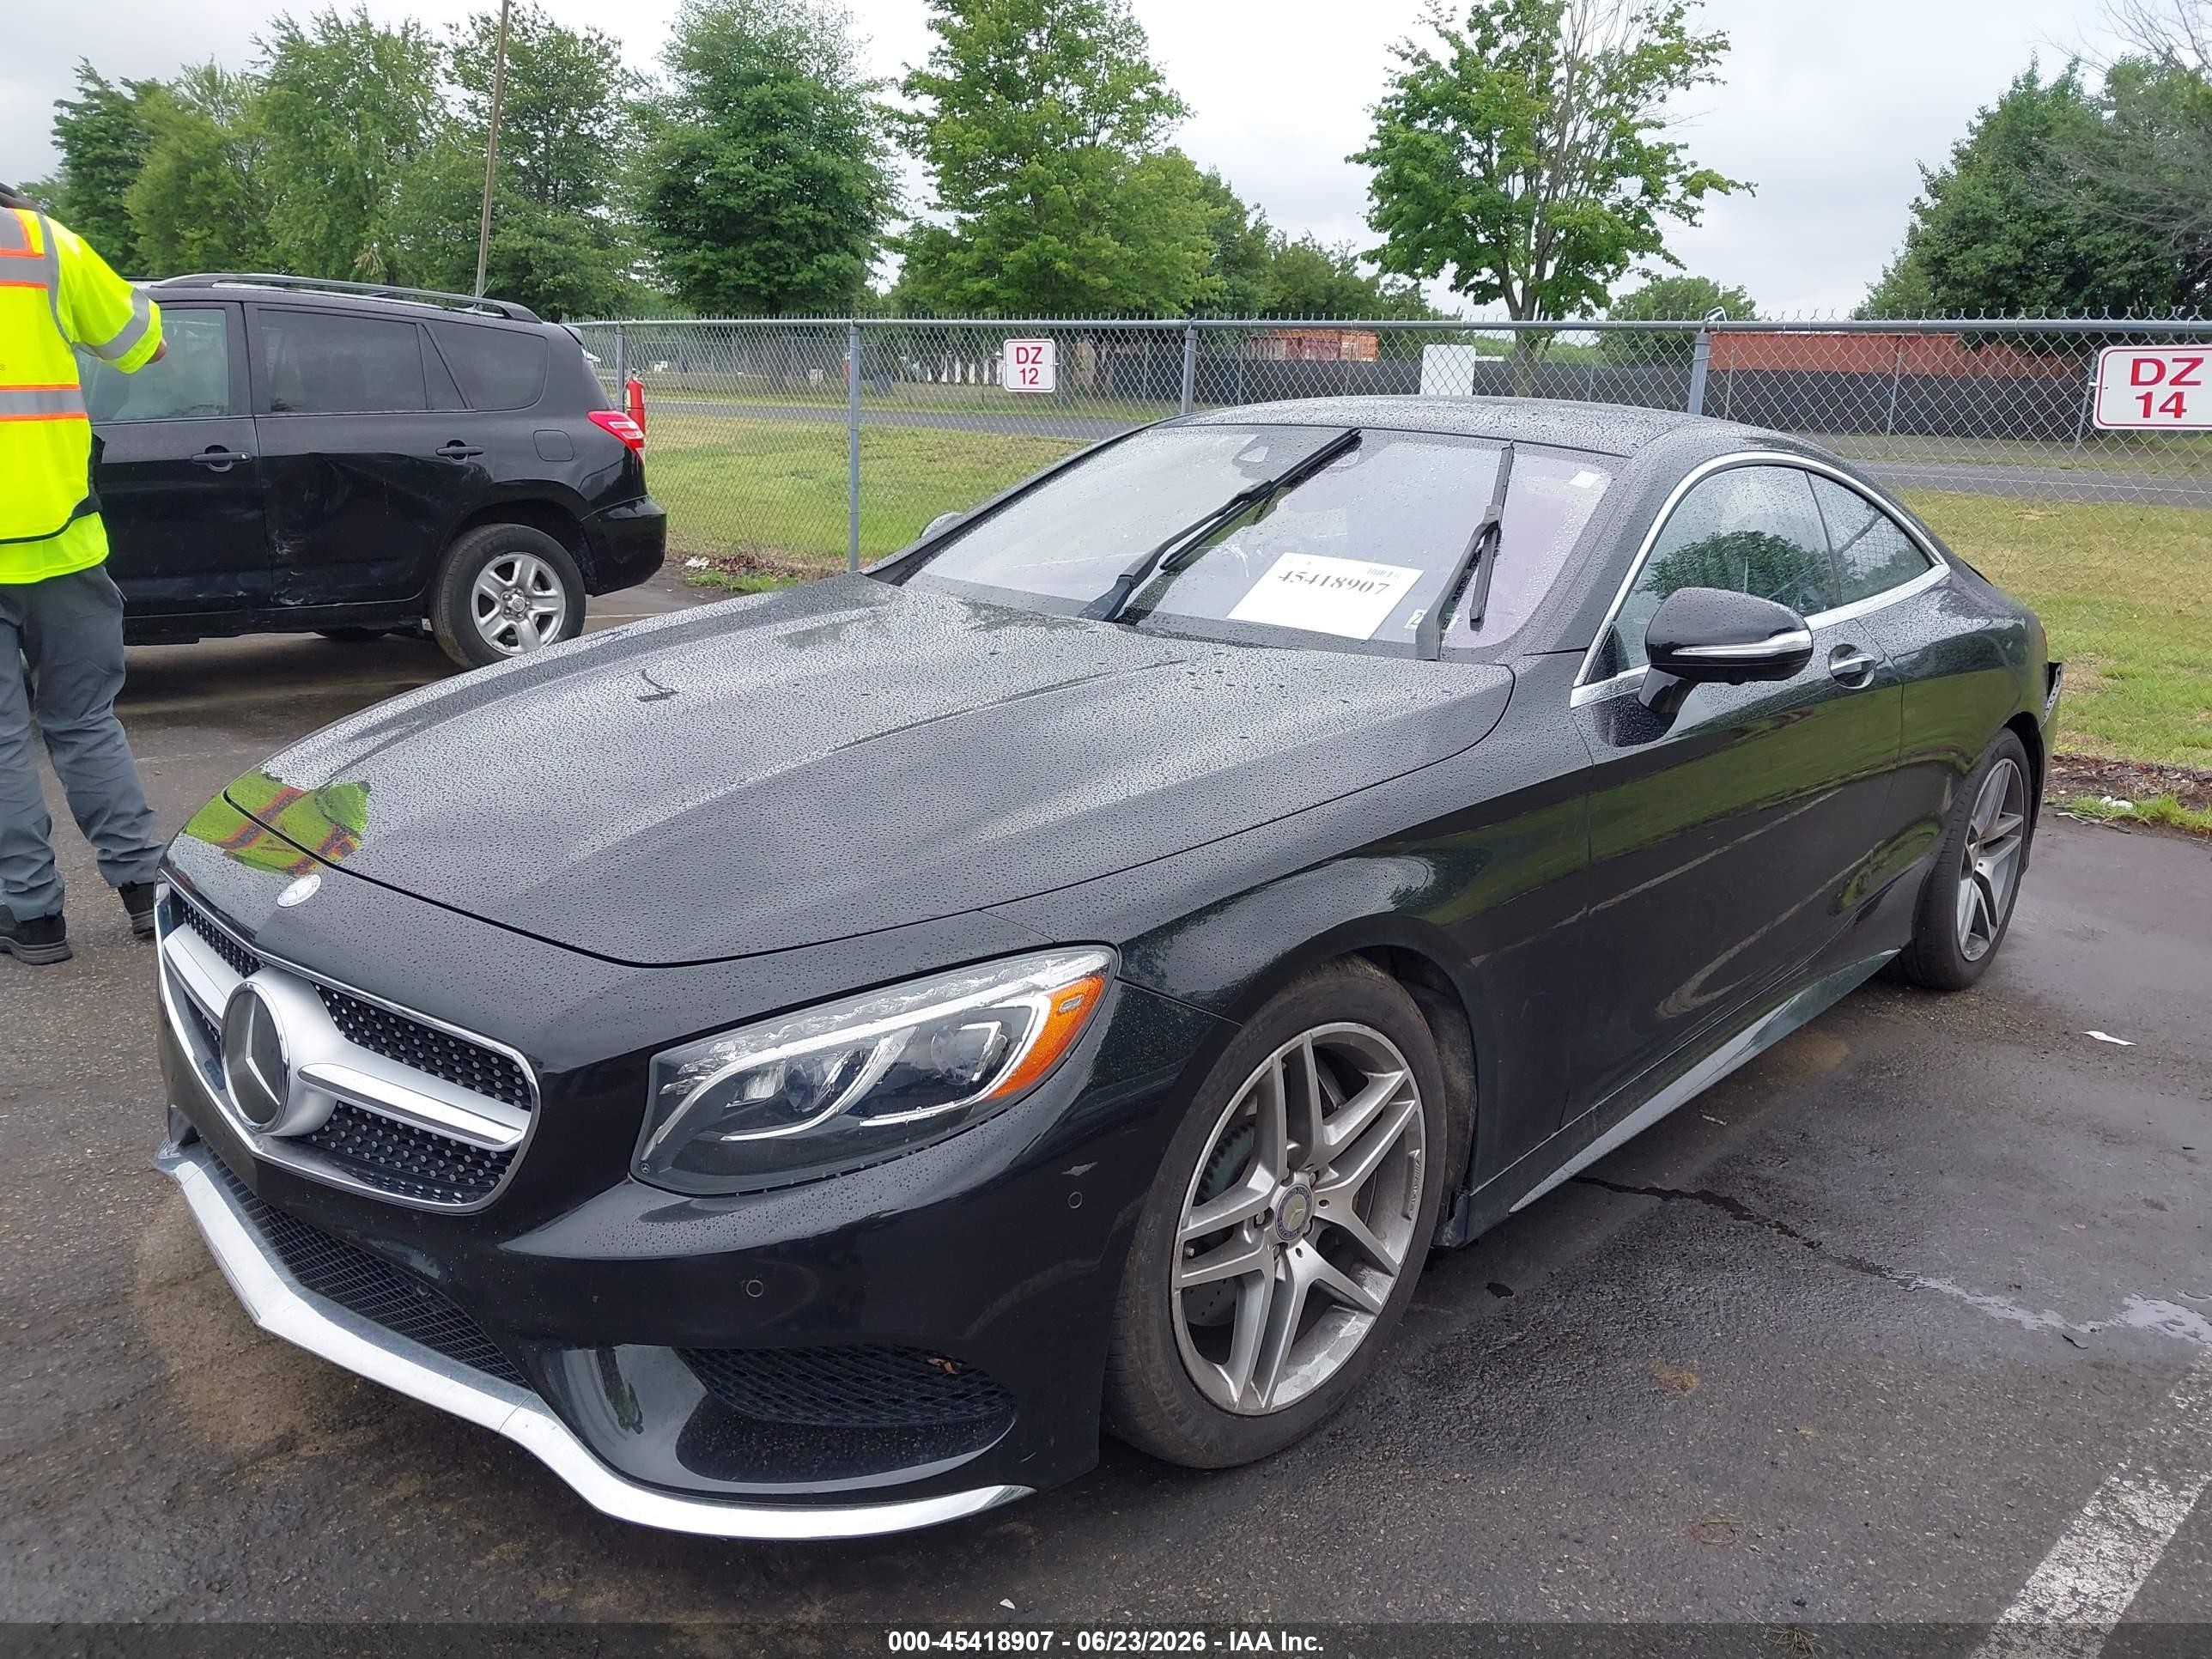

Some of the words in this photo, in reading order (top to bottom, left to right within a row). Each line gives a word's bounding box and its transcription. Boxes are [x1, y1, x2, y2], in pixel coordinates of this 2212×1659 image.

[1016, 347, 1043, 364] DZ
[1019, 368, 1039, 385] 12
[2130, 357, 2204, 386] DZ
[2135, 392, 2187, 418] 14
[1278, 570, 1390, 595] 45418907
